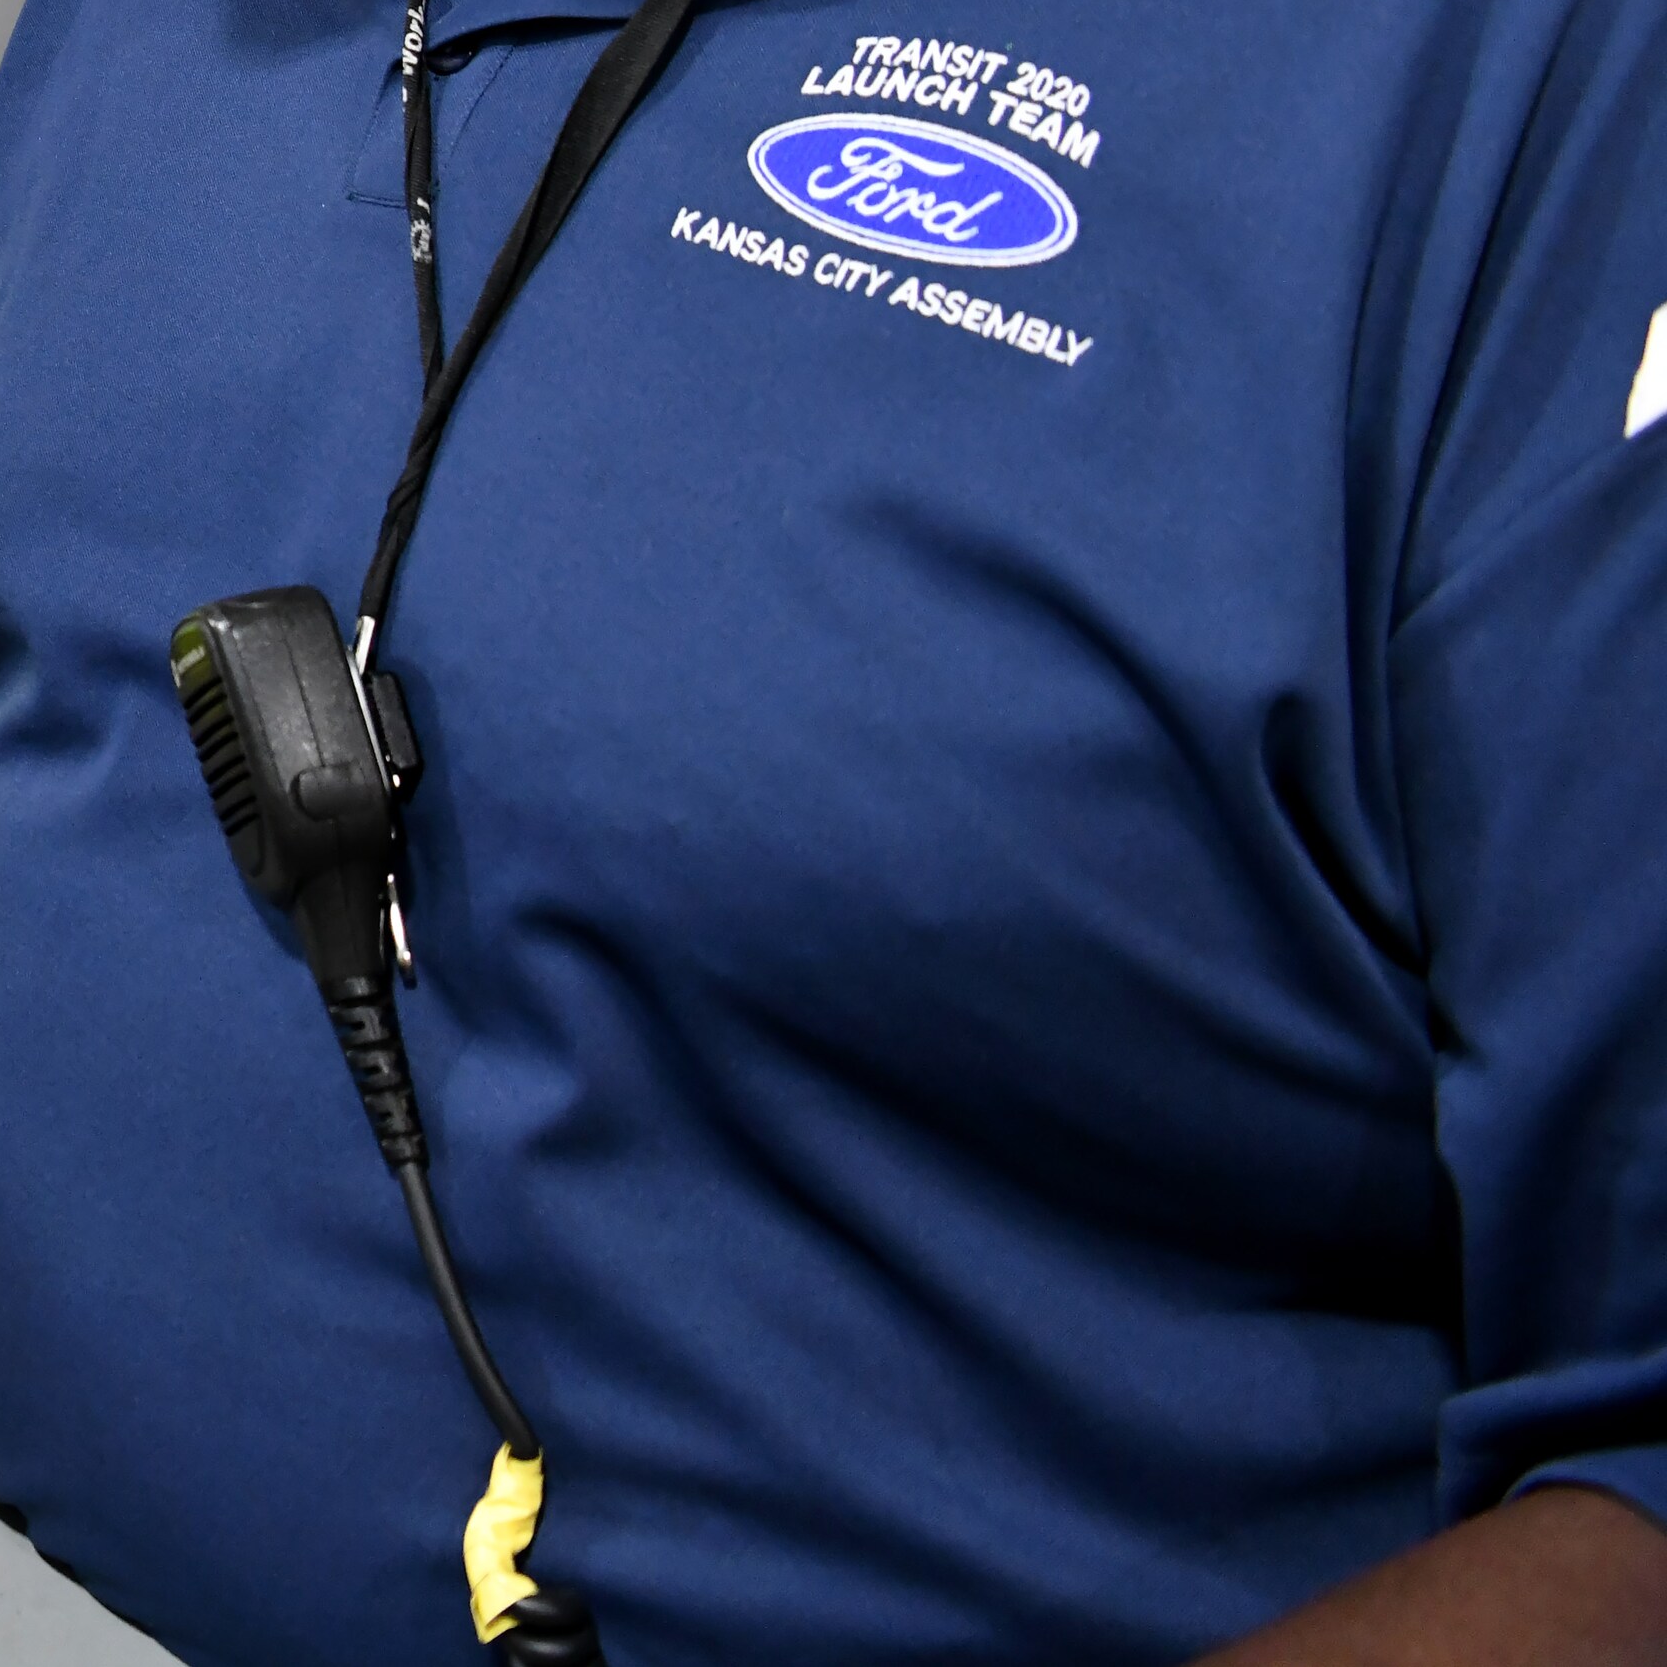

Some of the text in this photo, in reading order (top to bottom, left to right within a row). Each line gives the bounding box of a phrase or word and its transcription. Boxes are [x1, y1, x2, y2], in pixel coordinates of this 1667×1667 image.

[801, 64, 1101, 168] LAUNCH TEAM
[853, 36, 1091, 118] TRANSIT 2020
[806, 136, 1004, 244] Ford
[671, 206, 1094, 367] KANSAS CITY ASSEMBLY
